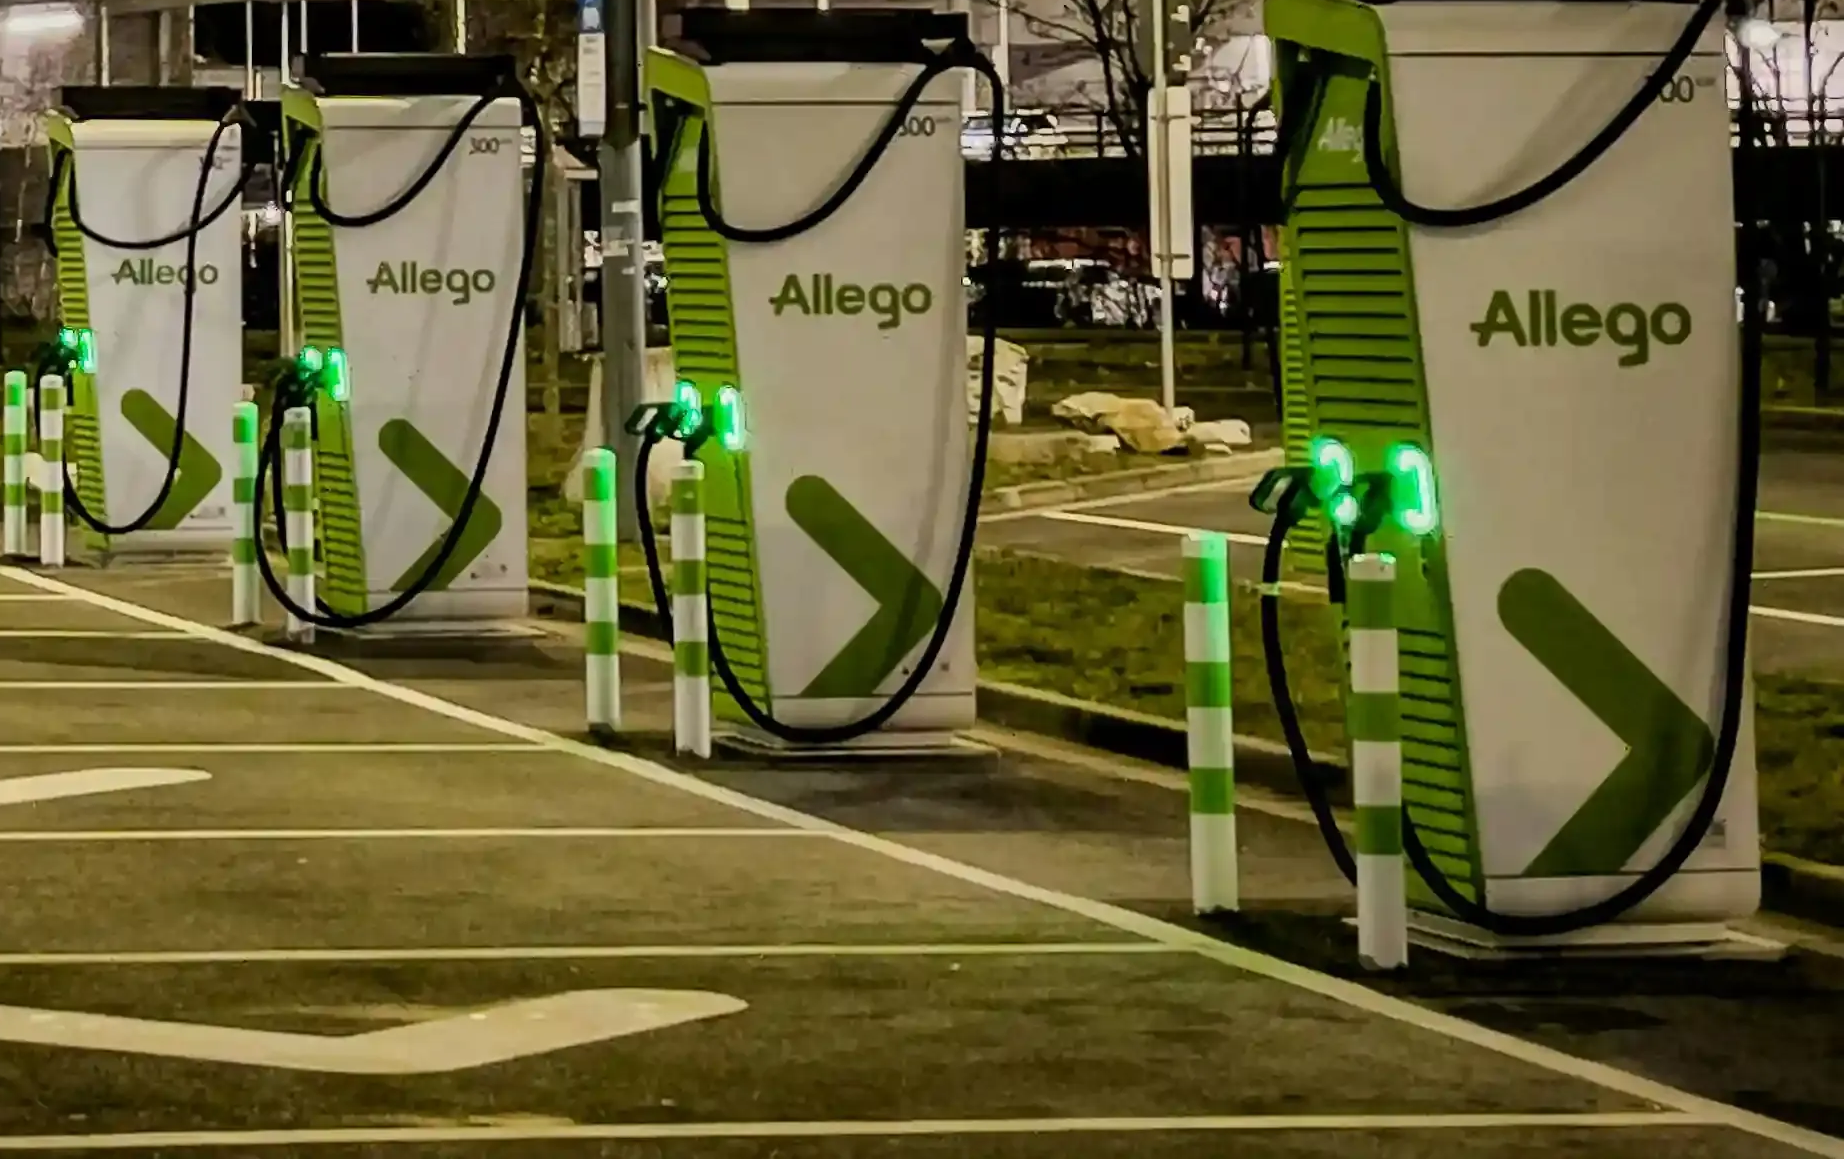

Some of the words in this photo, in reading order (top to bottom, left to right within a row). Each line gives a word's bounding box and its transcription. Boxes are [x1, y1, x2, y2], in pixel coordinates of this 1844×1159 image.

[1646, 75, 1694, 103] 00
[1318, 116, 1364, 162] Alleg
[365, 260, 495, 306] Allego
[768, 272, 933, 330] Allego
[1469, 288, 1692, 368] Allego
